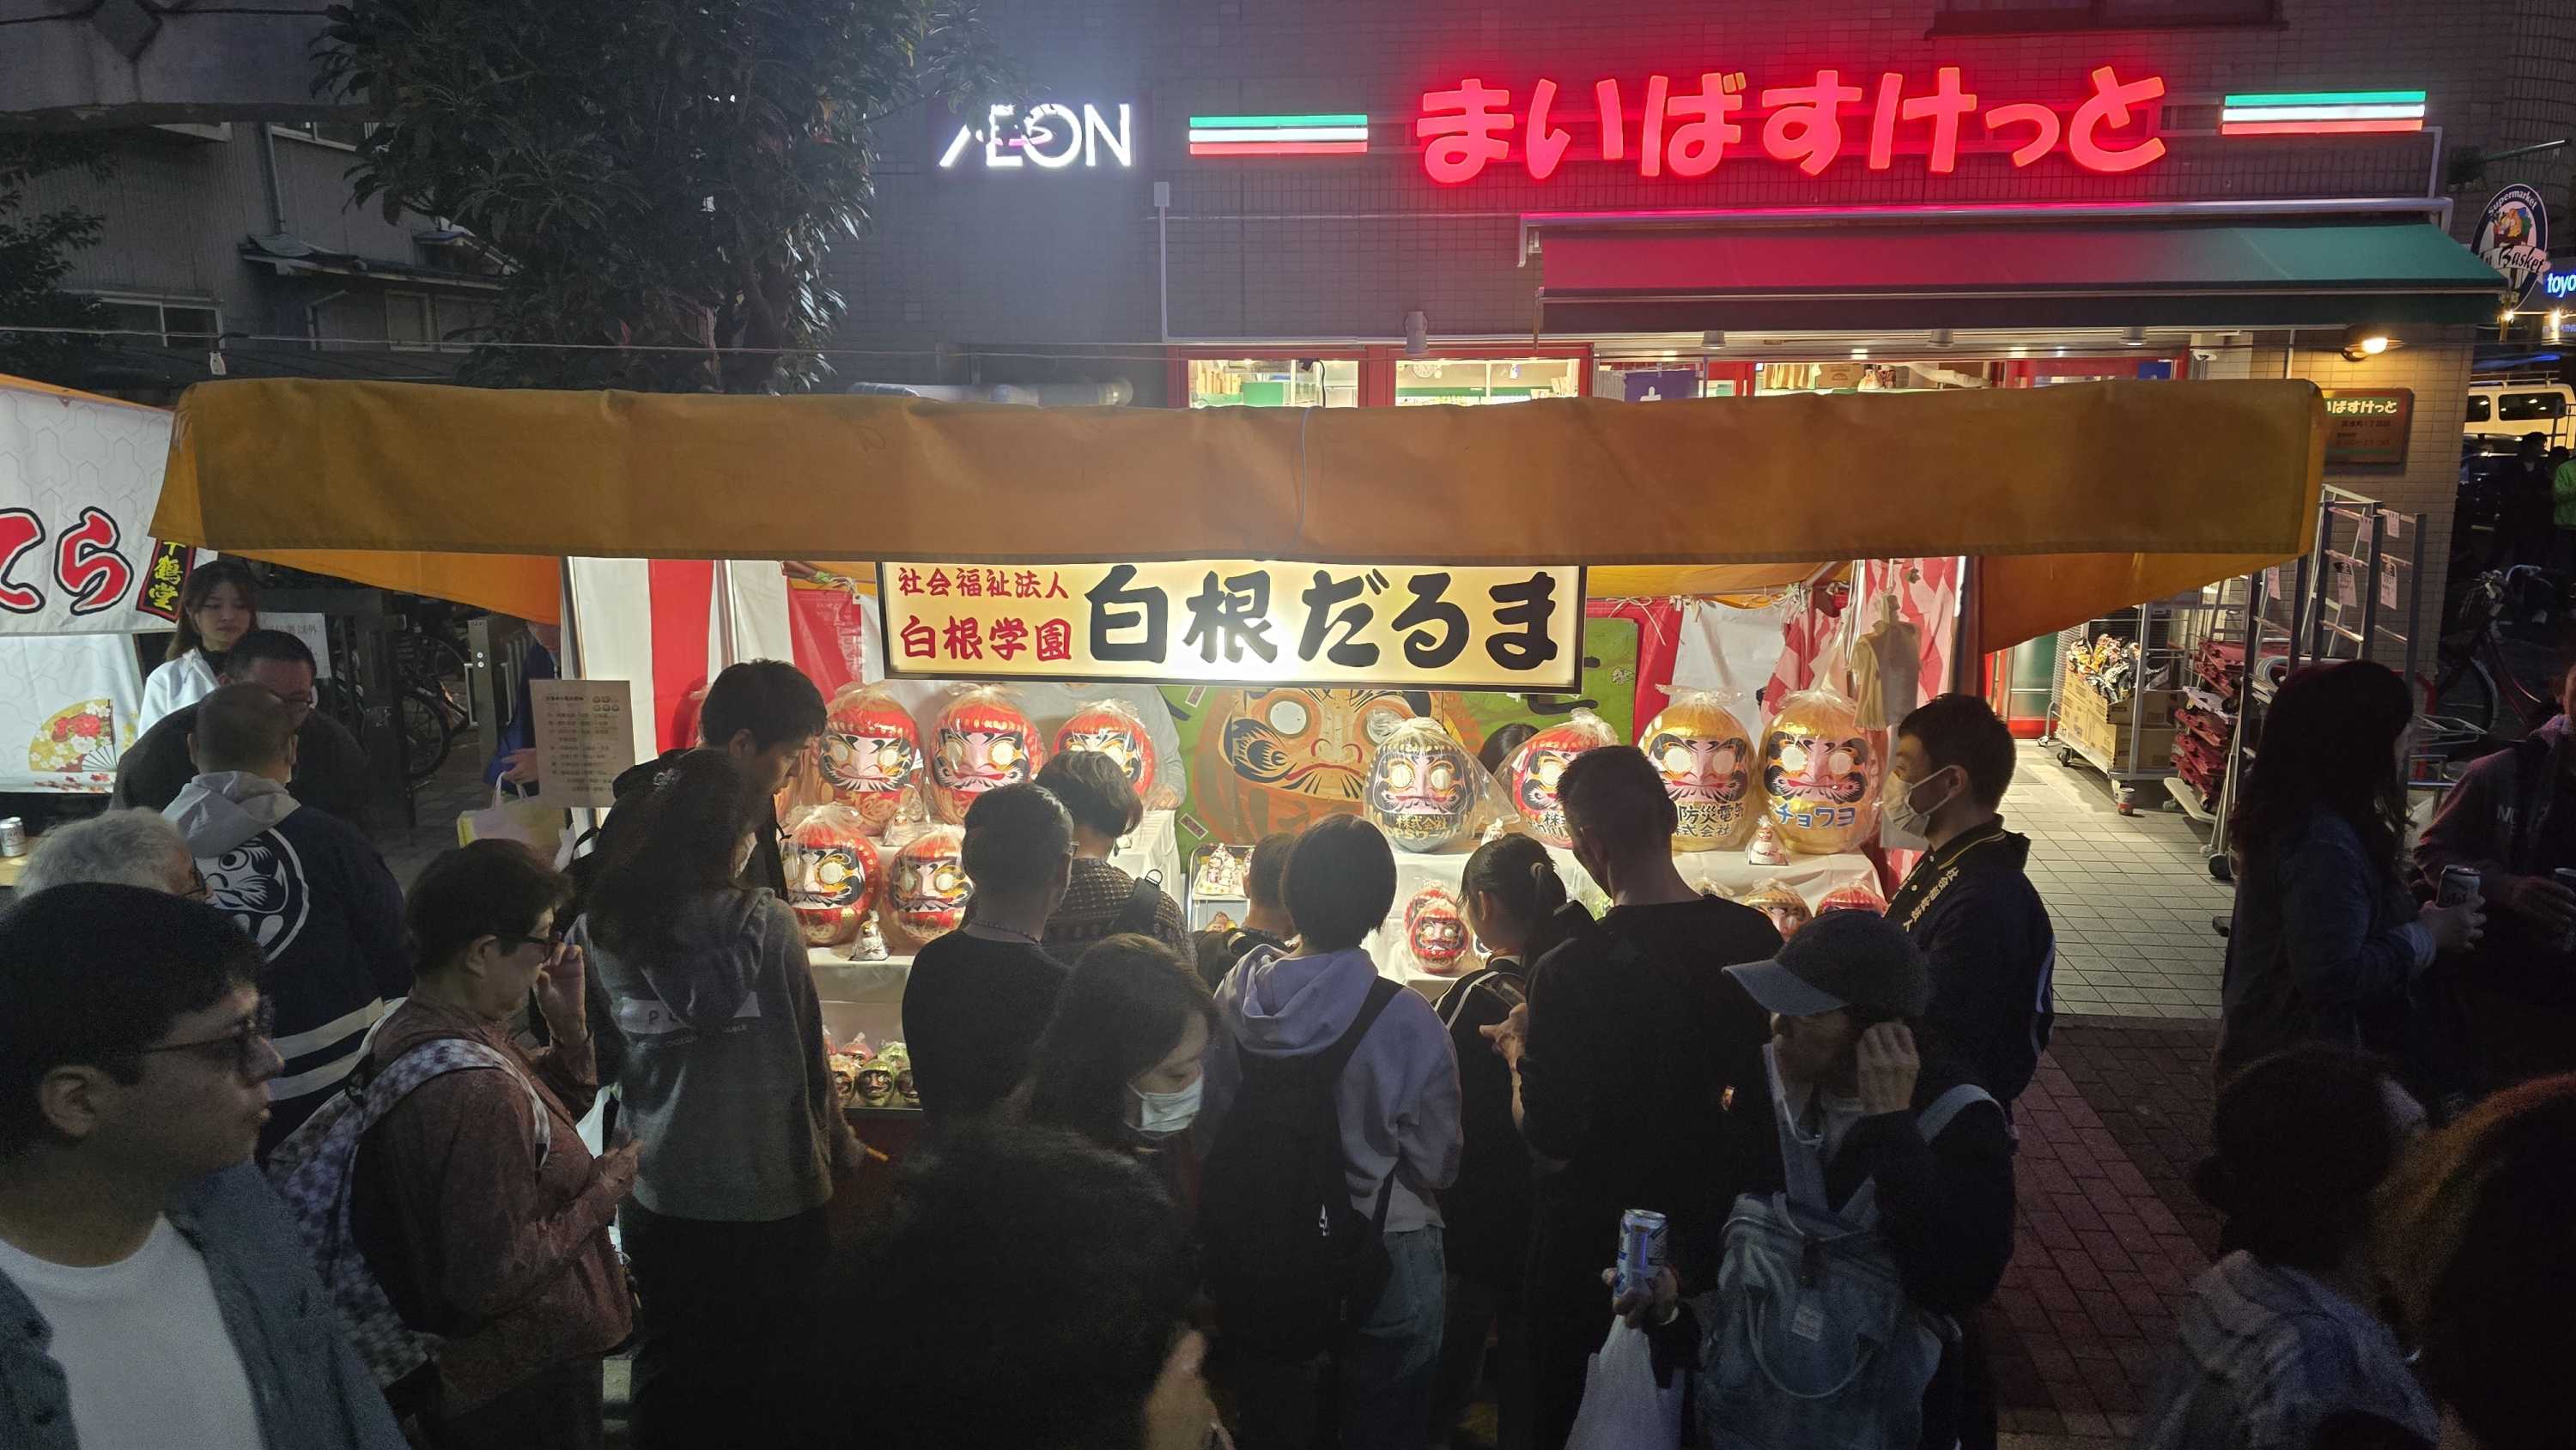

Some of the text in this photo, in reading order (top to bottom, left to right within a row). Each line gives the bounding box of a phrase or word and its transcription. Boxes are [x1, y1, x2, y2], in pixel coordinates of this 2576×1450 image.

[1416, 65, 2166, 184] まいばすけっと
[2488, 190, 2537, 216] Supermarket
[2497, 244, 2544, 274] Basket
[898, 567, 1070, 600] 社会福祉法人
[1084, 563, 1558, 671] 白根だるま
[899, 615, 1072, 662] 白根学園
[1395, 814, 1448, 831] 株式会社
[1774, 803, 1856, 829] チョワヨ
